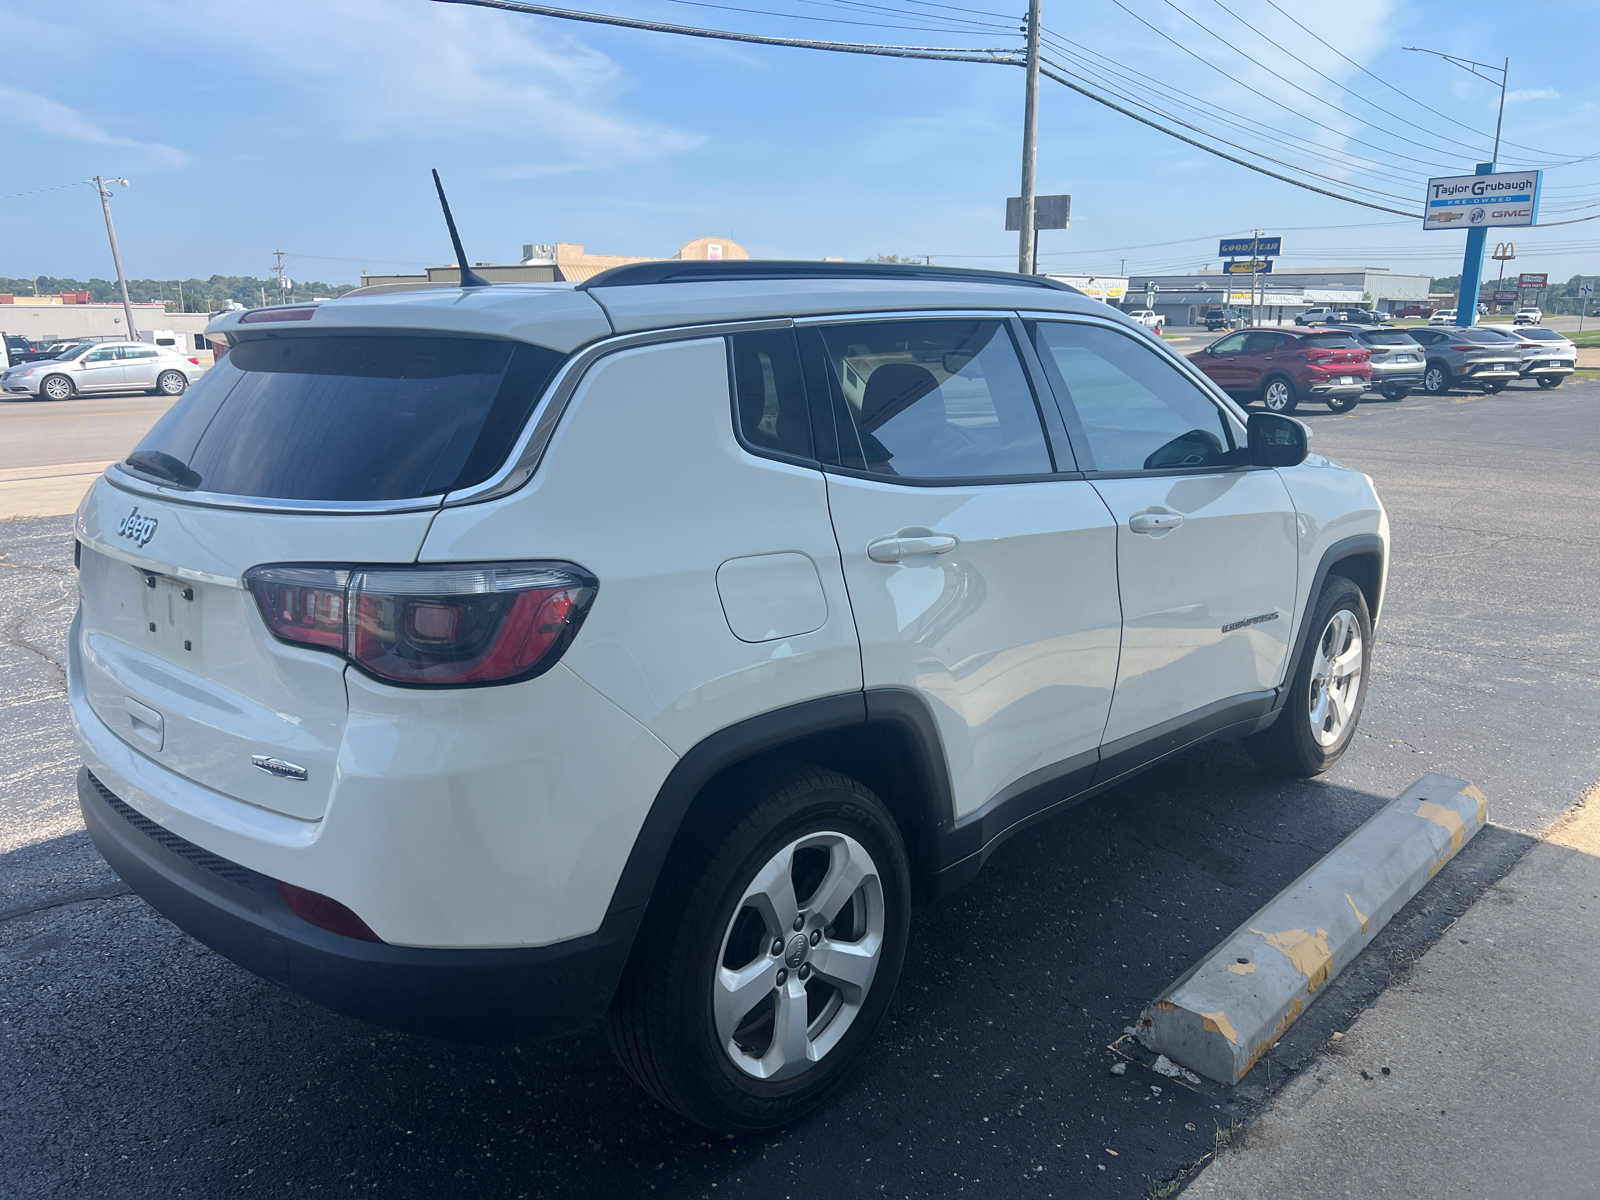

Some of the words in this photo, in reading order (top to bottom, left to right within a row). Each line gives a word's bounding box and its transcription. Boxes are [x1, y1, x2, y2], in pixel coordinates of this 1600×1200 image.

[1432, 184, 1469, 198] Taylor
[1471, 179, 1533, 196] Grubaugh
[1447, 196, 1512, 205] PRE-OWNED
[1491, 209, 1531, 218] GMC
[117, 506, 158, 548] Jeep
